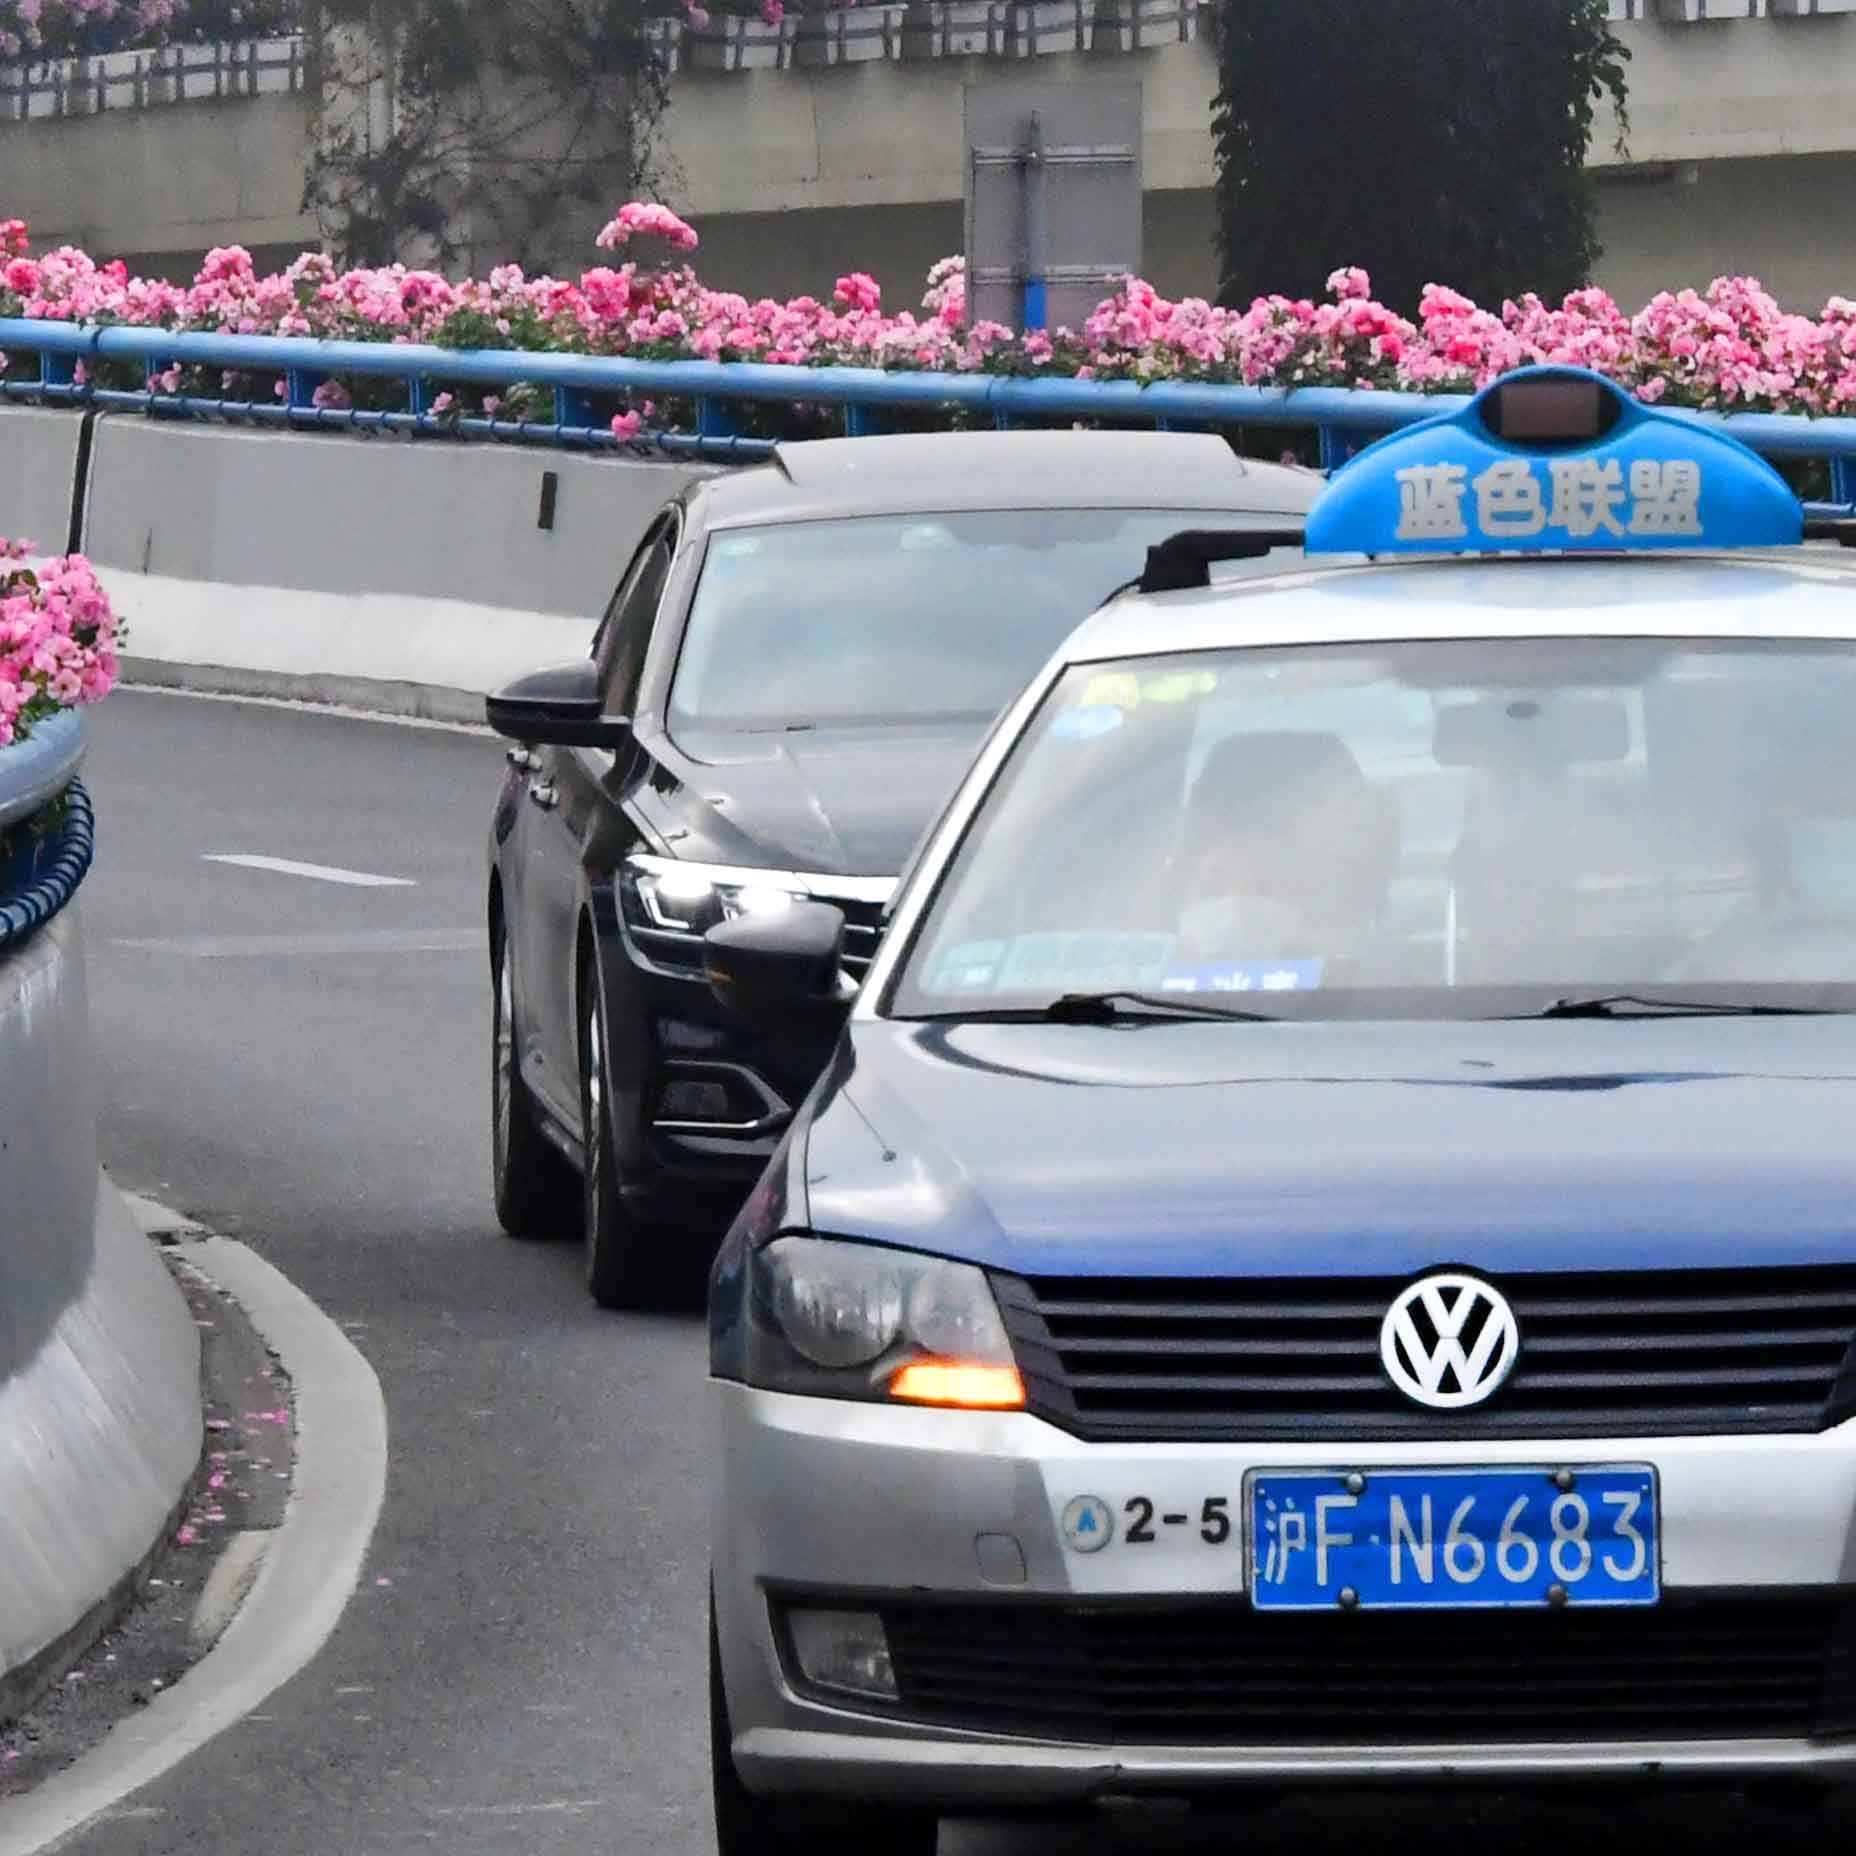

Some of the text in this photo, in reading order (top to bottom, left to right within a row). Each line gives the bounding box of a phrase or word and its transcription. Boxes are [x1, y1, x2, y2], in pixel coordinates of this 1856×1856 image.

[1395, 460, 1702, 538] 蓝色联盟
[1124, 1496, 1231, 1545] 2-5
